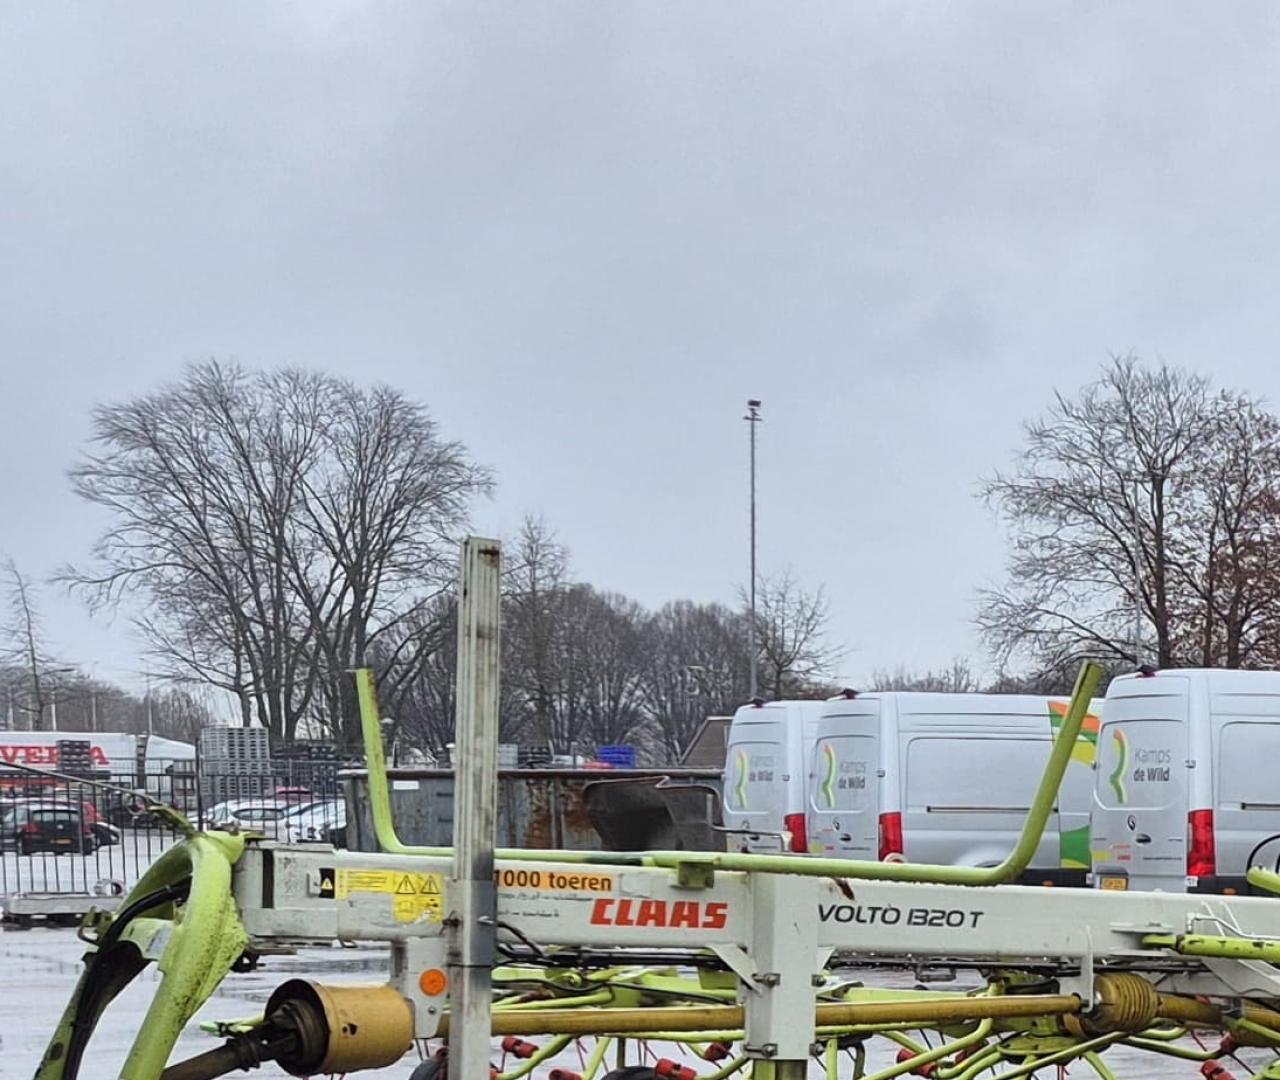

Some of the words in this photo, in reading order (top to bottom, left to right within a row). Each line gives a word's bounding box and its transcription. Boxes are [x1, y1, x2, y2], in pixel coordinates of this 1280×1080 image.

[1135, 749, 1171, 764] Kamps
[1133, 768, 1145, 782] de
[1147, 767, 1170, 782] Wild
[495, 870, 541, 888] 1000
[549, 871, 612, 891] toeren
[590, 898, 728, 929] CLAAS
[818, 904, 901, 925] VOLTO
[907, 908, 965, 928] 1320
[970, 911, 984, 928] T
